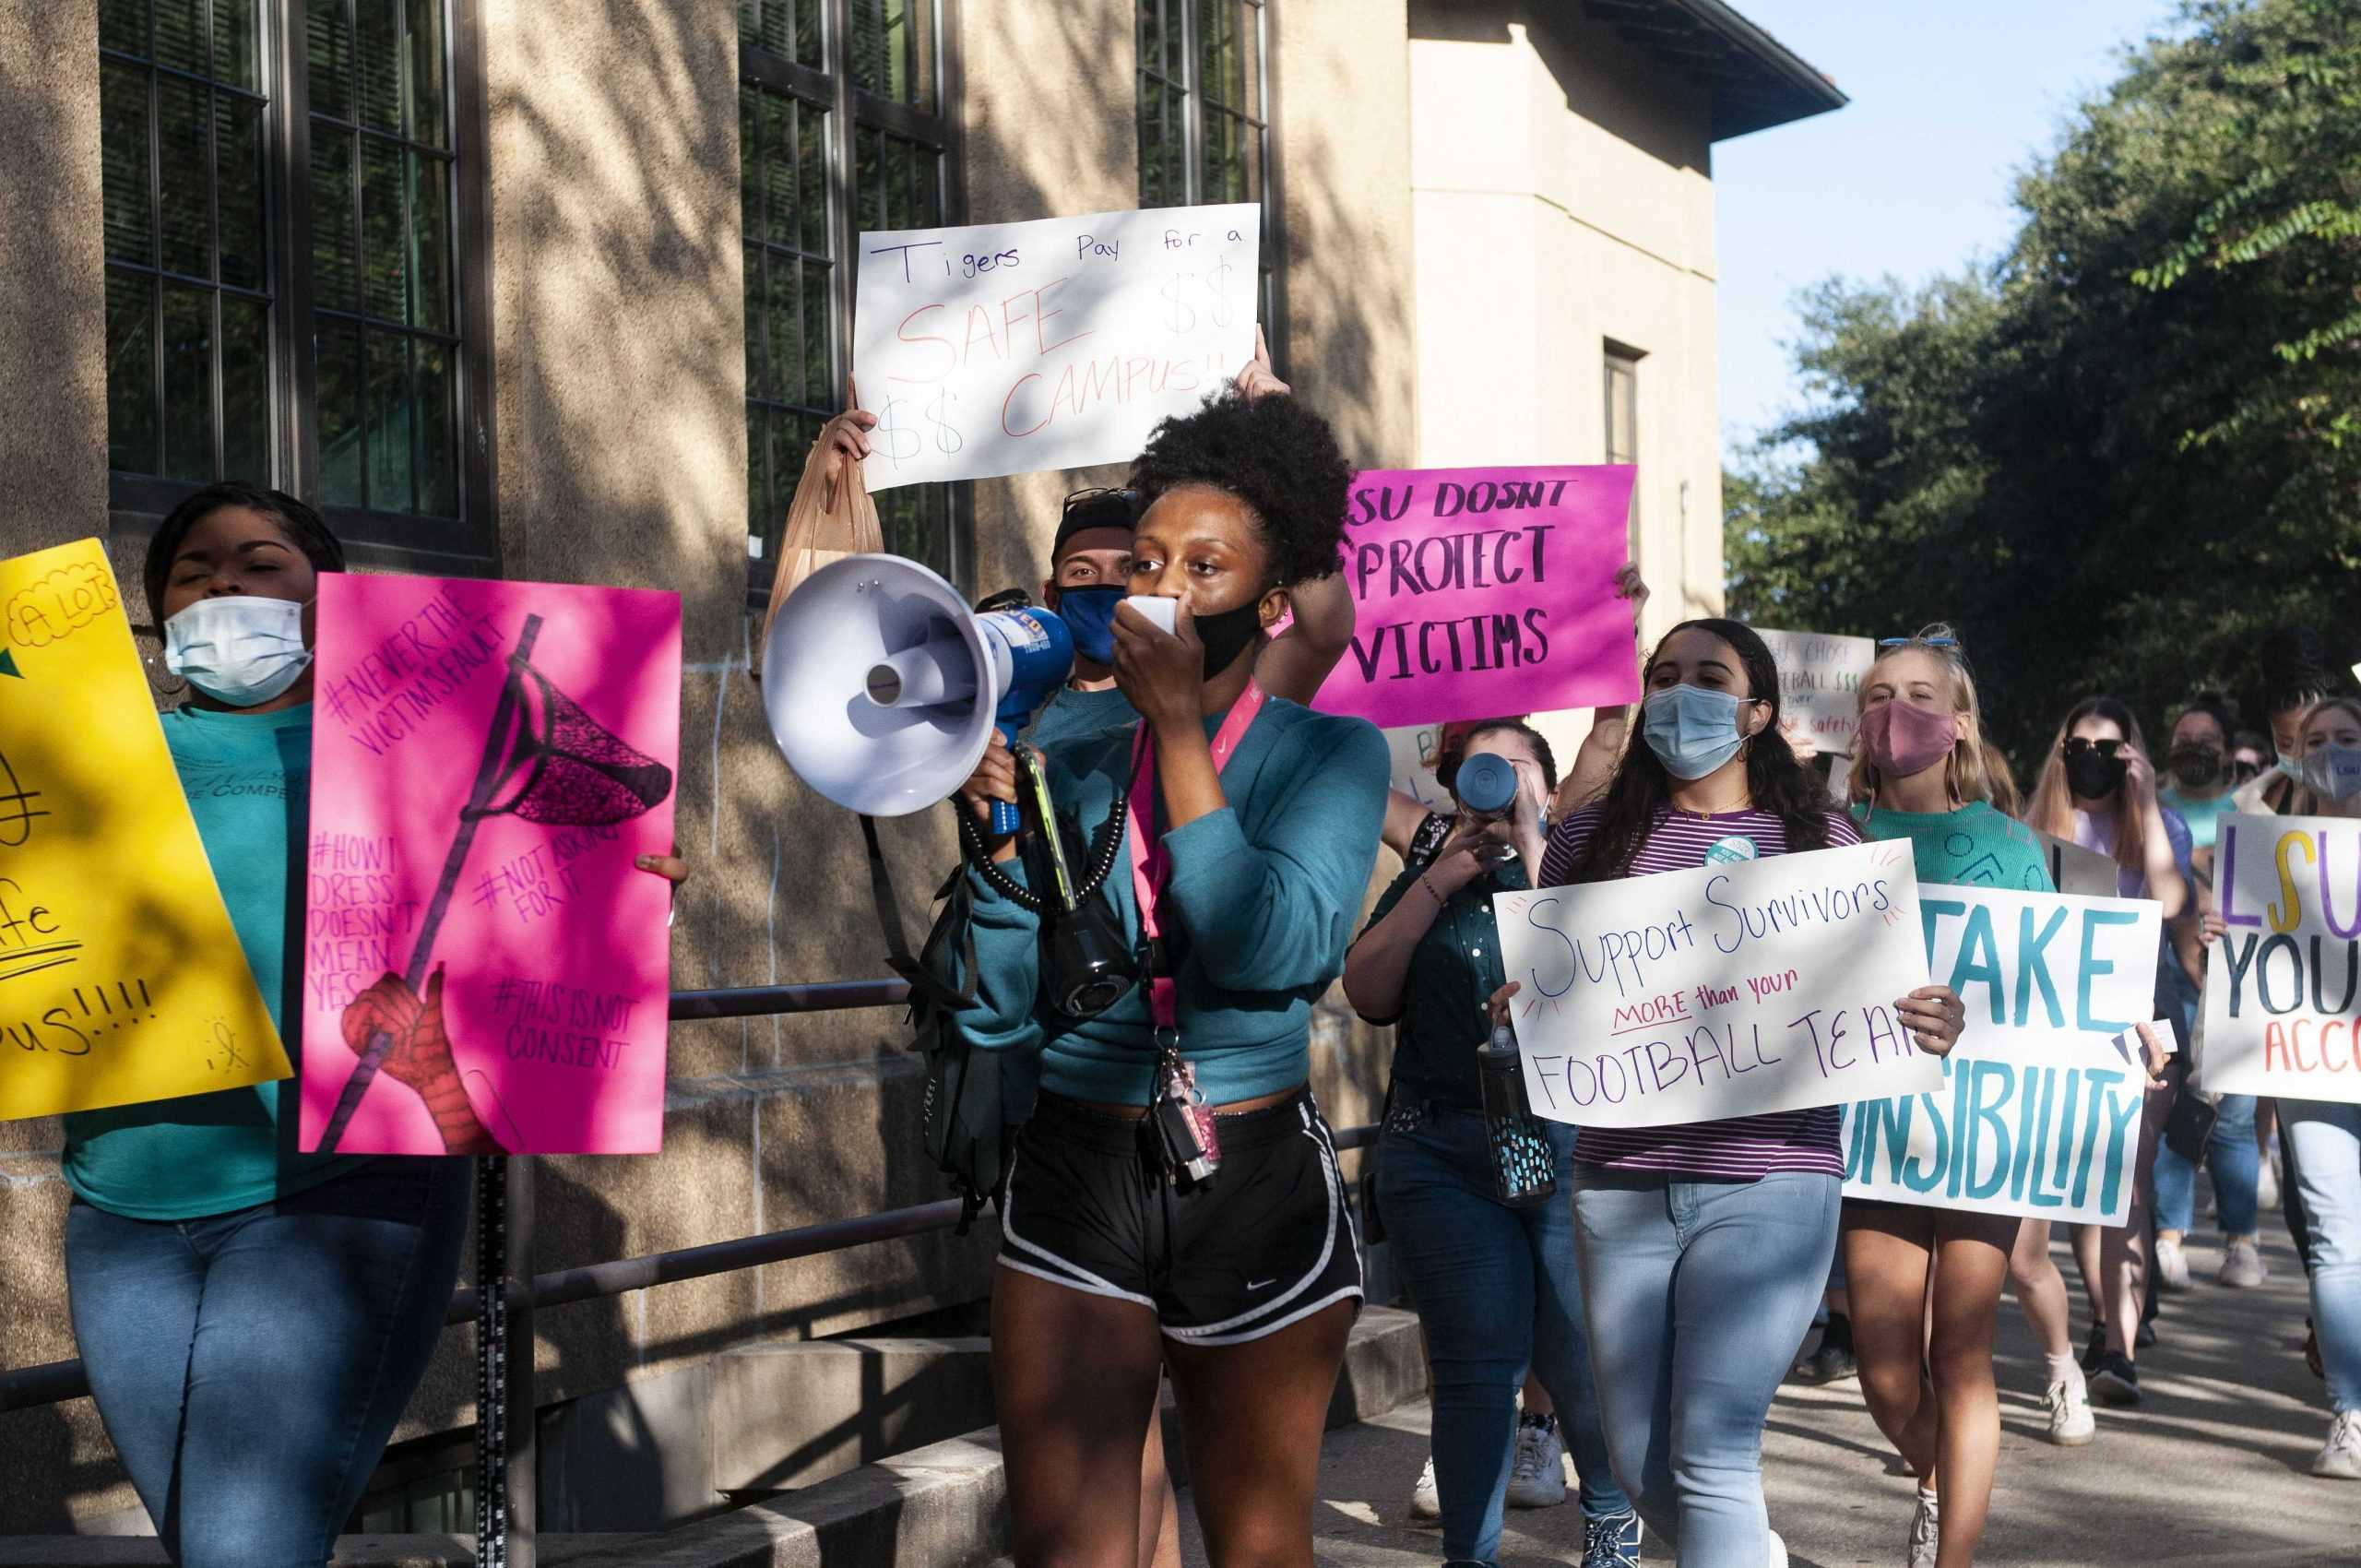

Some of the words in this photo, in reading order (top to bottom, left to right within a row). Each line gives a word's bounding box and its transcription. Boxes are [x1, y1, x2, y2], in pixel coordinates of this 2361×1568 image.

[870, 241, 1020, 283] Tigers
[1076, 234, 1121, 262] Pay
[1164, 229, 1201, 251] for
[1227, 229, 1242, 244] a
[887, 277, 1095, 384] SAFE
[1345, 484, 1414, 527] SU
[1433, 479, 1579, 517] DOSNT
[1357, 525, 1556, 600] PROTECT
[20, 605, 53, 634] A
[56, 575, 109, 620] LOT
[323, 620, 438, 726] #NEVER
[418, 584, 474, 641] THE
[1349, 607, 1548, 683] VICTIMS
[310, 831, 384, 870] #HOW
[471, 844, 545, 909] #NOT
[0, 877, 60, 949] fe
[311, 873, 396, 907] DRESS
[515, 880, 564, 923] FOR
[2221, 825, 2361, 940] LSU
[311, 936, 392, 972] MEAN
[1527, 897, 1694, 999] Support
[1706, 875, 1890, 954] Survivors
[1920, 898, 2141, 1034] TAKE
[0, 978, 157, 1056] us!!!!
[308, 972, 360, 1012] YES
[488, 976, 565, 1026] #THIS
[593, 992, 642, 1034] NOT
[1612, 990, 1690, 1029] MORE
[1695, 983, 1739, 1013] than
[1747, 968, 1798, 1006] your
[506, 1022, 631, 1070] CONSENT
[1532, 1023, 1782, 1110] FOOTBALL
